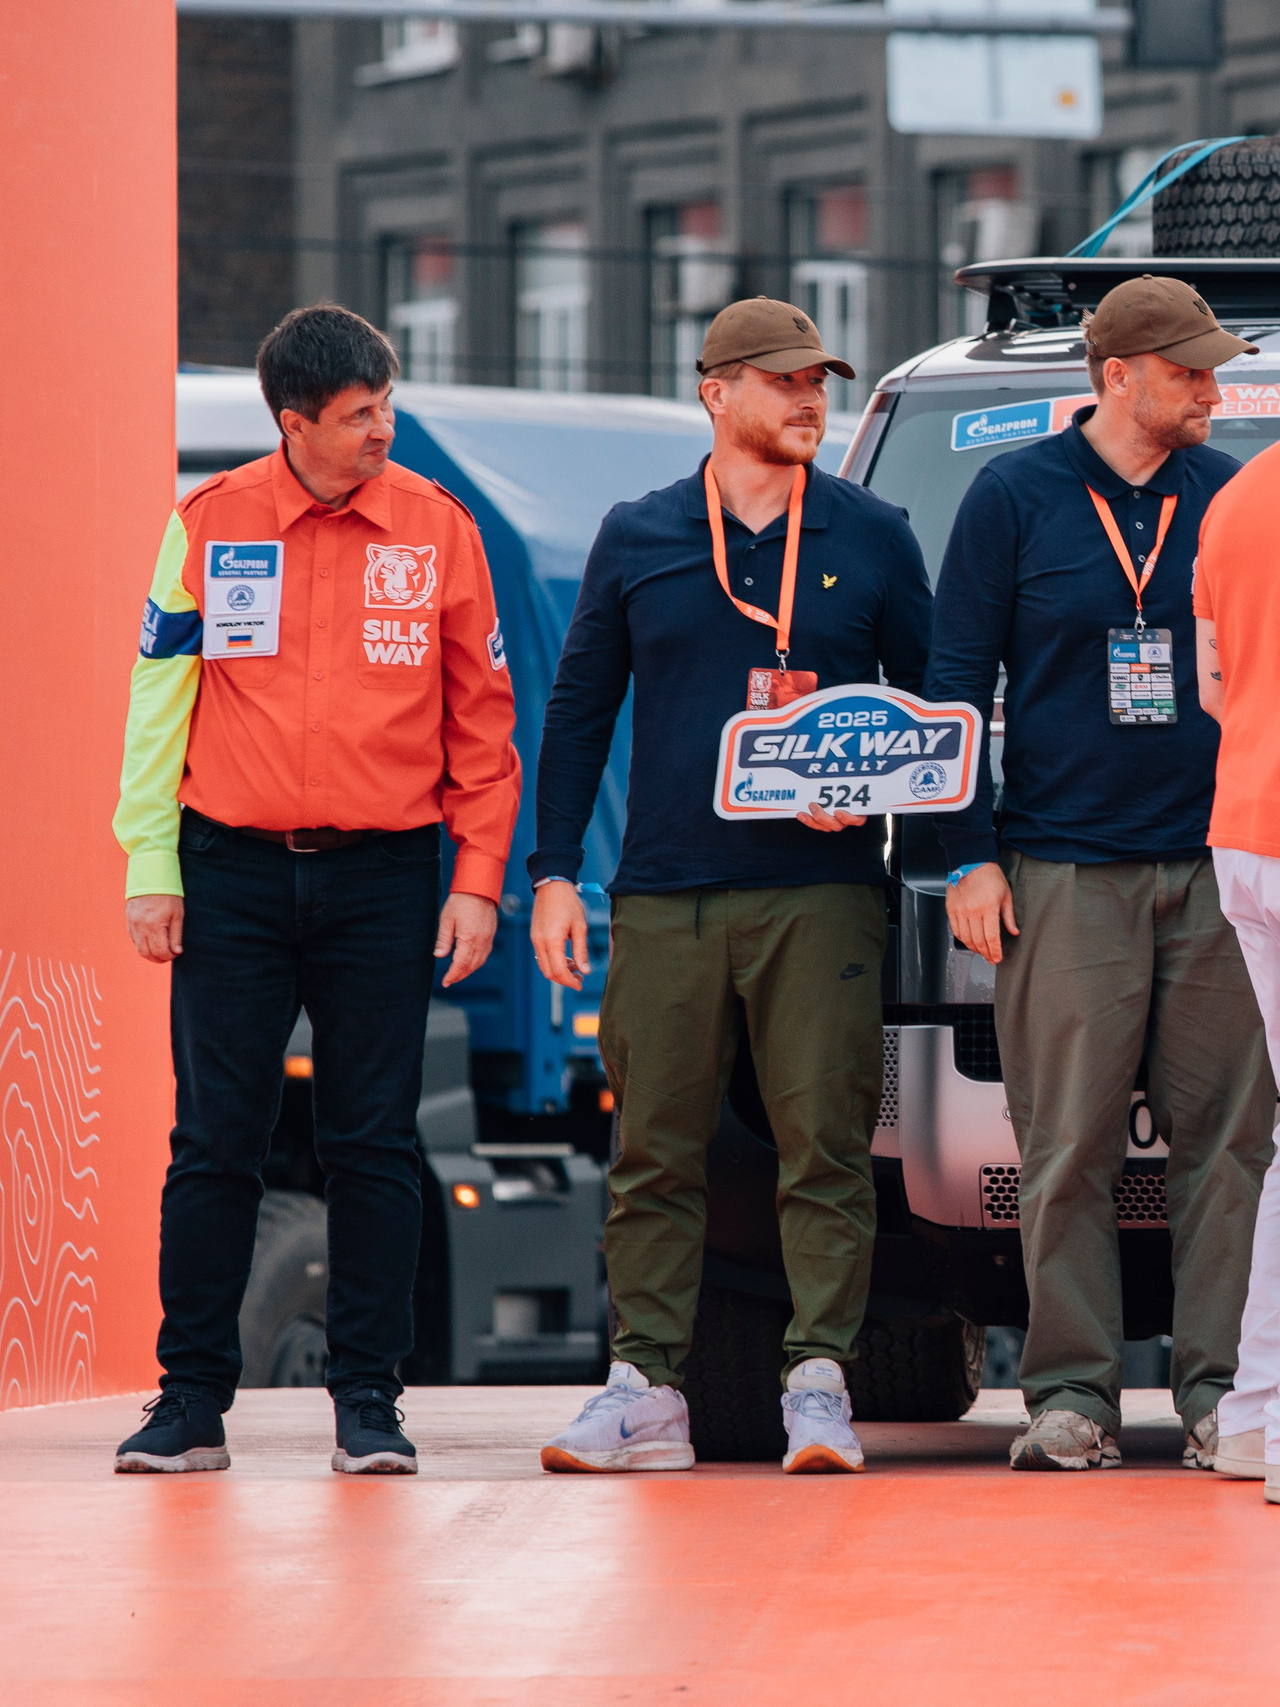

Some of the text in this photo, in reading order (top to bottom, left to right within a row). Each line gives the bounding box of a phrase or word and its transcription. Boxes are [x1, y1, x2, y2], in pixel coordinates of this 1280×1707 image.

[987, 418, 1038, 435] GAZPROM
[233, 560, 268, 569] GAZPROM
[363, 619, 429, 644] SILK
[362, 642, 429, 666] WAY
[817, 710, 889, 729] 2025
[747, 728, 953, 761] SILK WAY
[807, 760, 889, 774] RALLY
[752, 789, 796, 801] GAZPROM
[817, 784, 871, 809] 524
